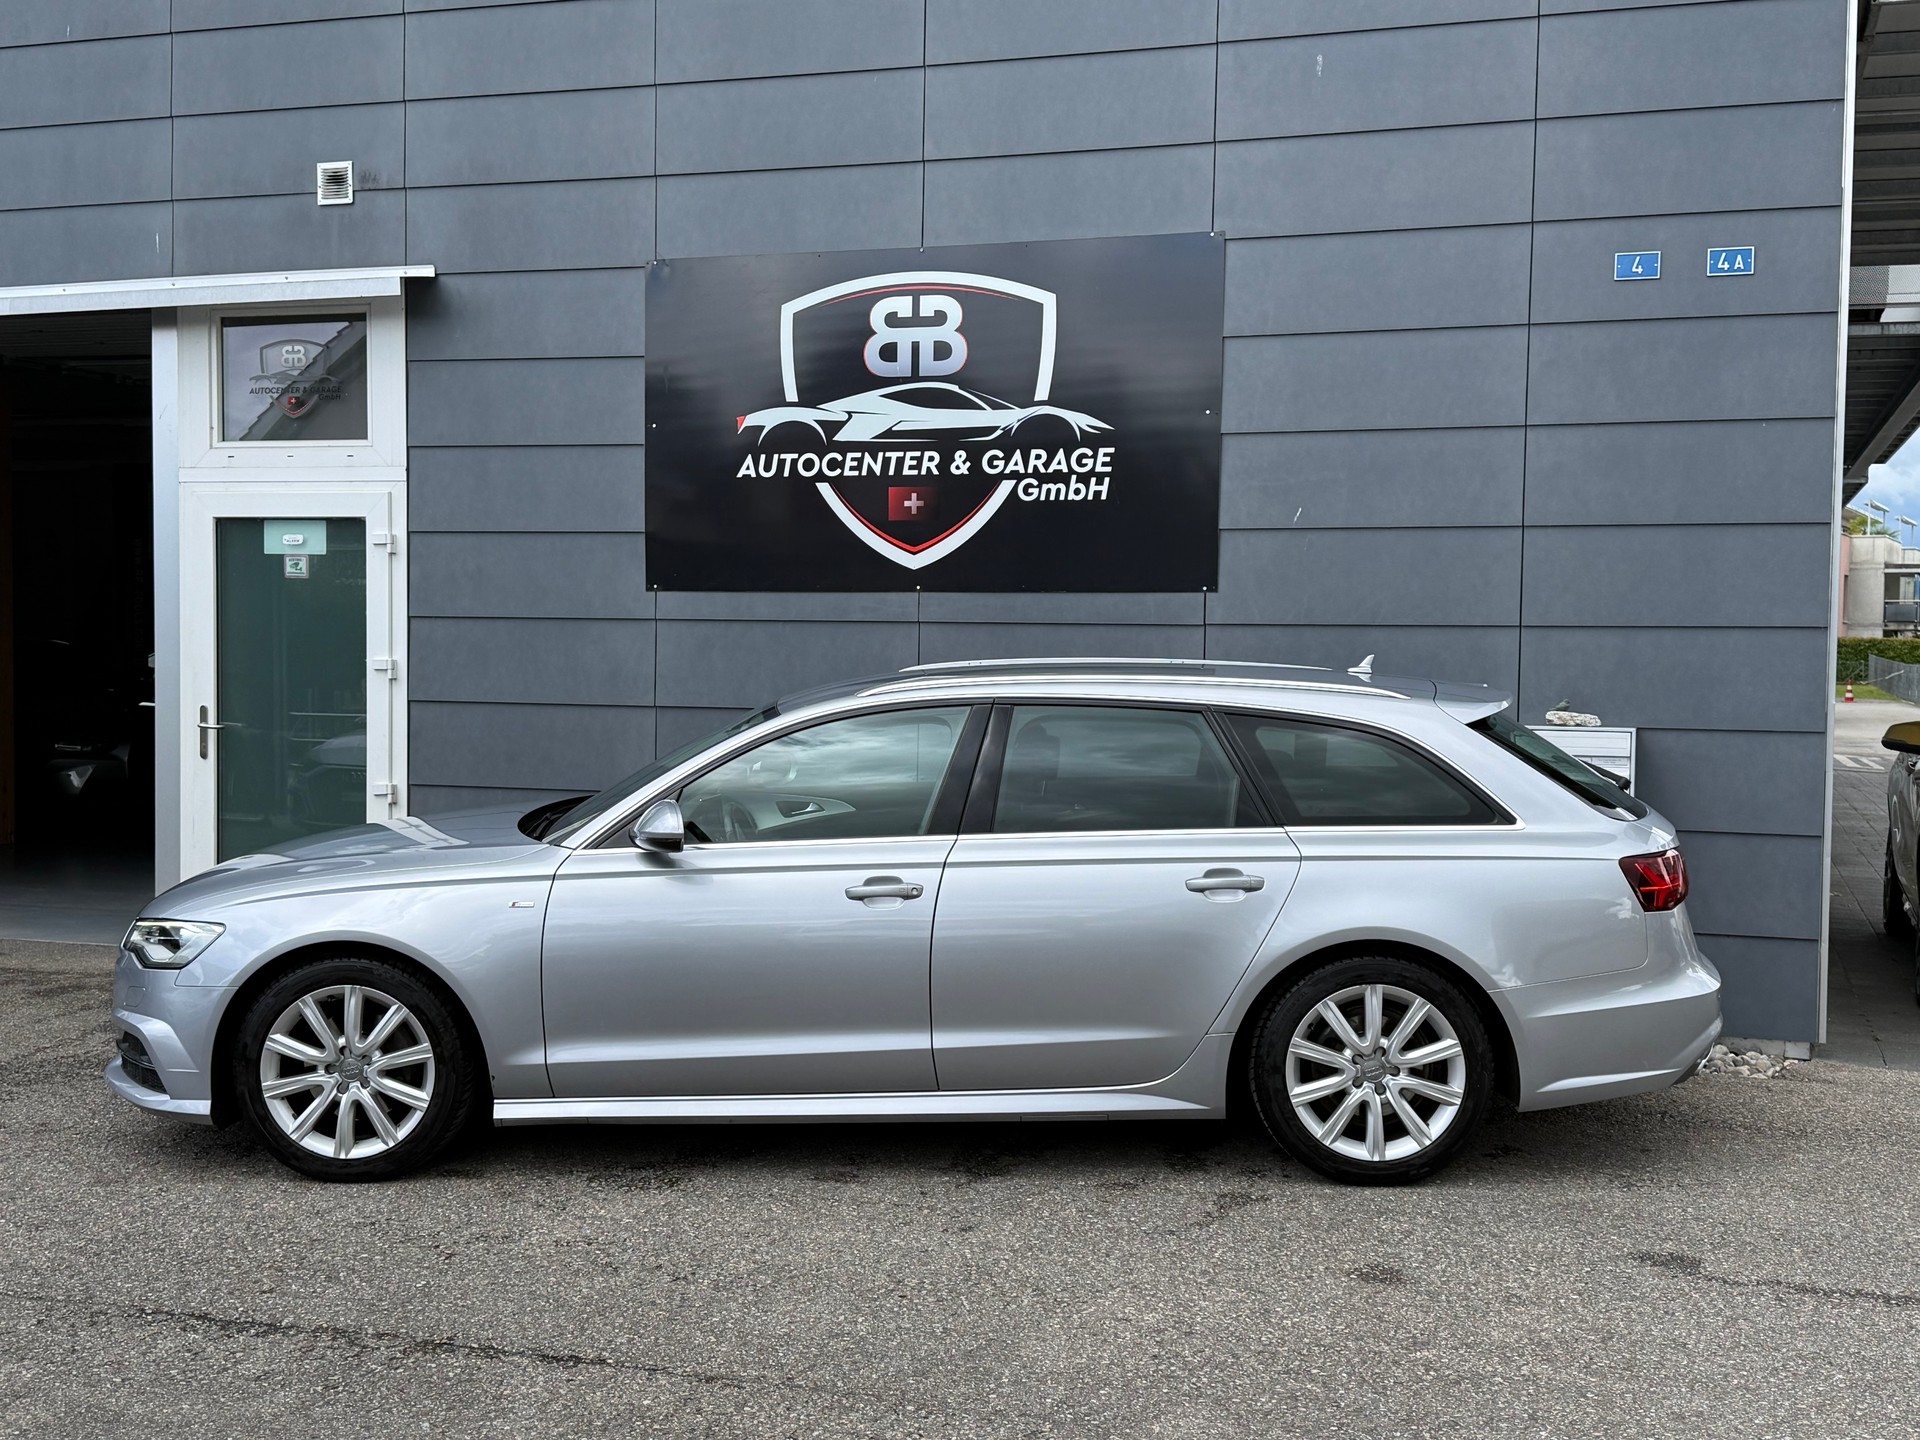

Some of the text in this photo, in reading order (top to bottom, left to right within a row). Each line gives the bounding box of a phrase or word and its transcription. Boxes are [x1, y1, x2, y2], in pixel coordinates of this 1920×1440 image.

[1631, 255, 1644, 275] 4
[249, 386, 301, 395] AUTOCENTER
[310, 385, 342, 394] GARAGE
[736, 446, 1115, 479] AUTOCENTER & GARAGE
[1017, 475, 1110, 503] GmbH
